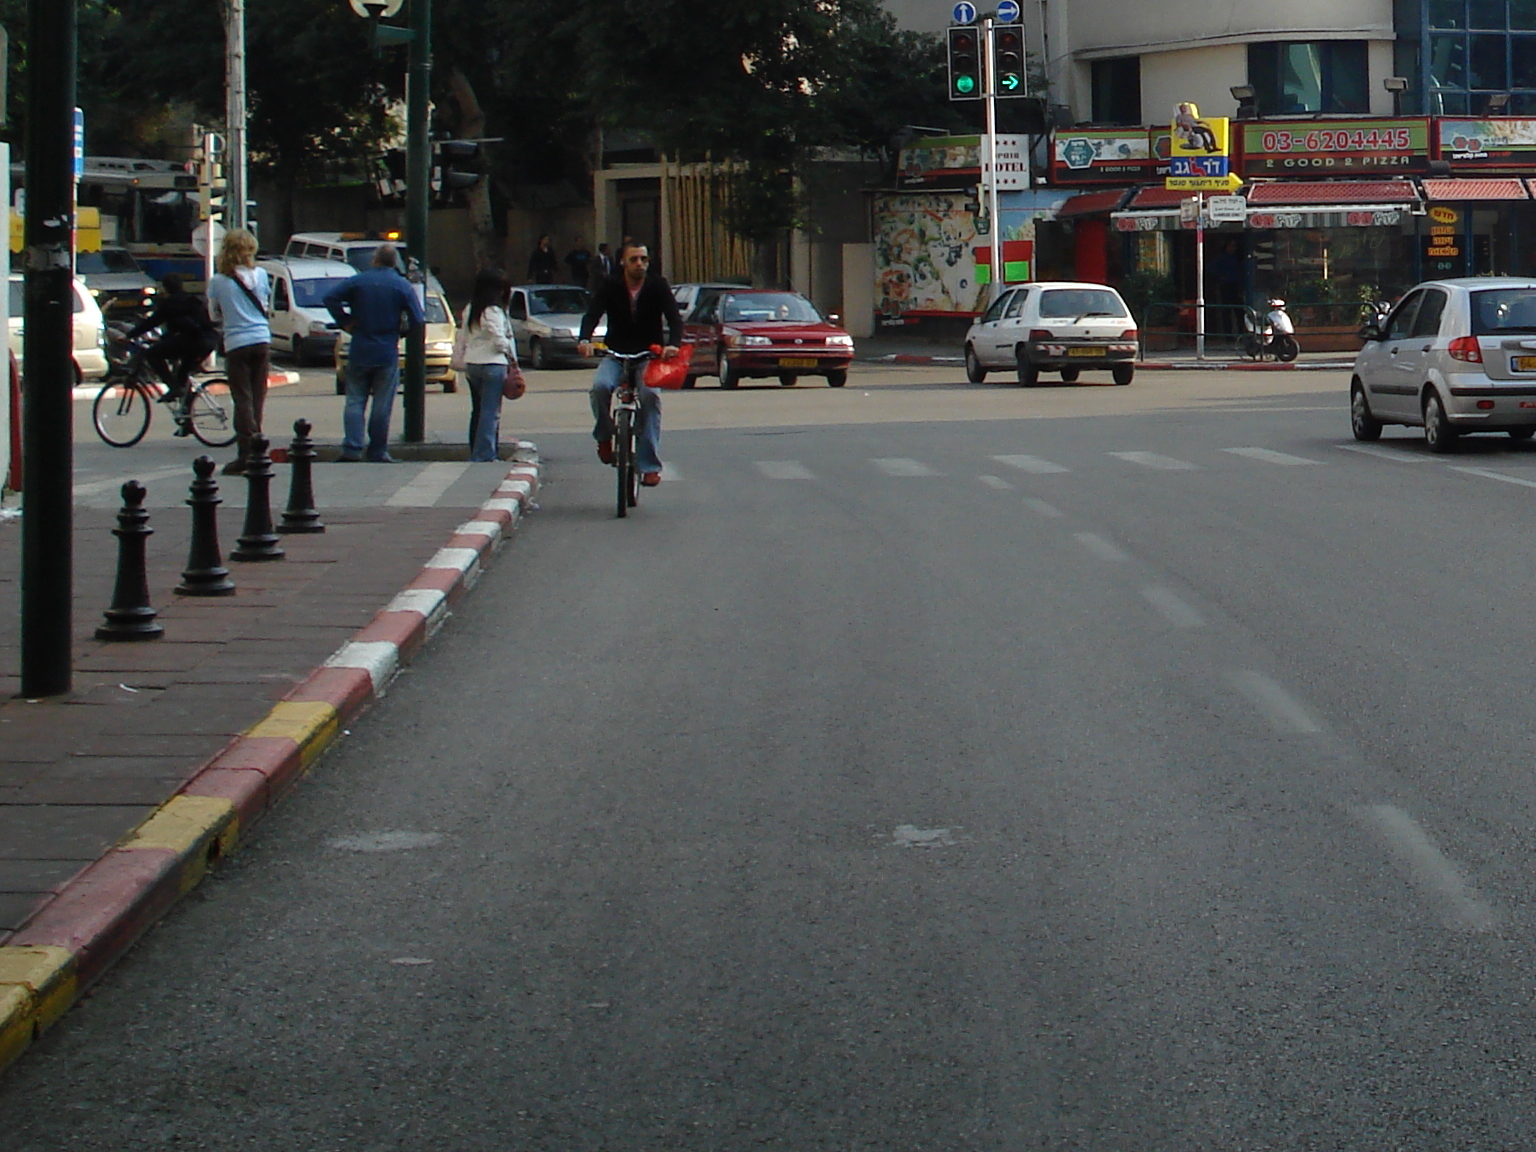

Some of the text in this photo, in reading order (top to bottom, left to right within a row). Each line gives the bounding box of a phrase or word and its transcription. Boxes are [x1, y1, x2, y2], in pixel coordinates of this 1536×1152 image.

[1261, 127, 1411, 152] 03-6204445
[1284, 157, 1335, 167] GOOD
[1362, 156, 1410, 166] PIZZA
[984, 162, 1027, 173] OTEL
[1434, 210, 1454, 221] חדש
